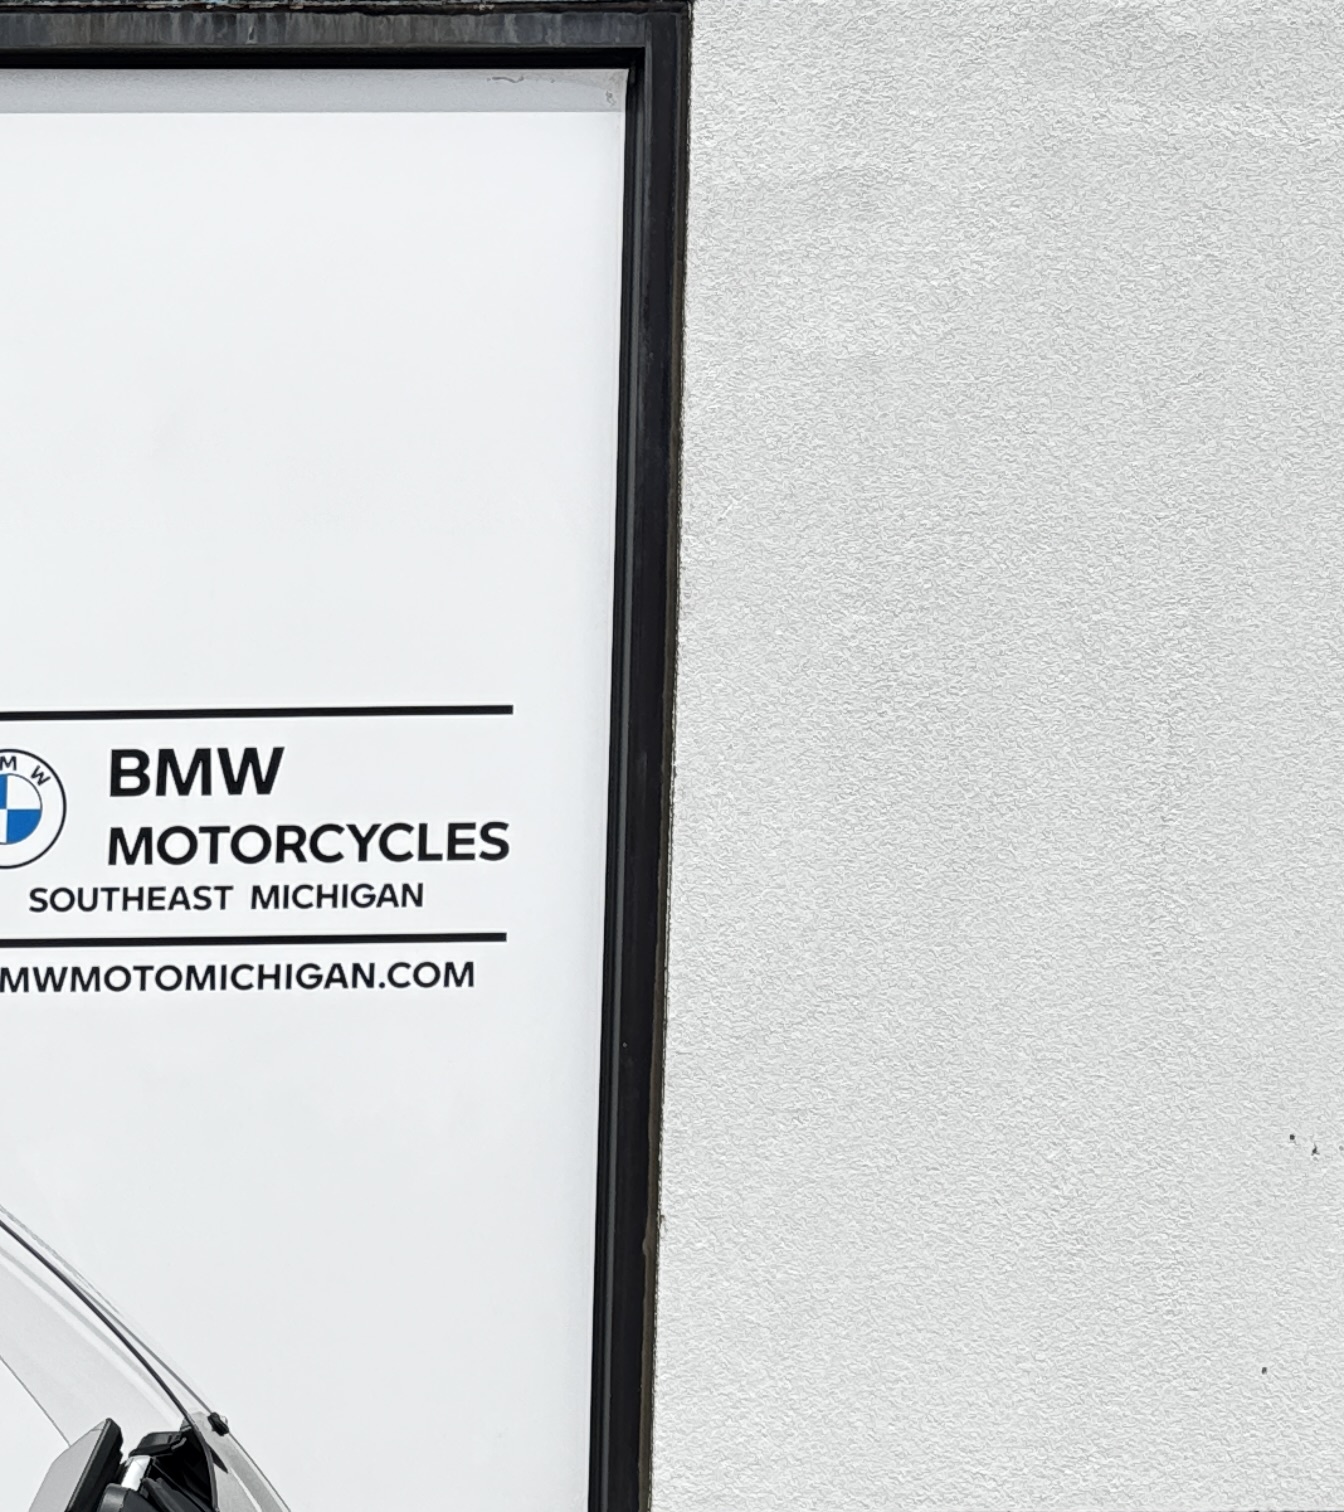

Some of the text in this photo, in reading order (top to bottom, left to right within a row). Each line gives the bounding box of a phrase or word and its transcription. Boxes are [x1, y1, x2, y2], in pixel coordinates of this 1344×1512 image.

[110, 747, 284, 797] BMW
[109, 822, 509, 865] MOTORCYCLES
[30, 883, 423, 912] SOUTHEAST MICHIGAN
